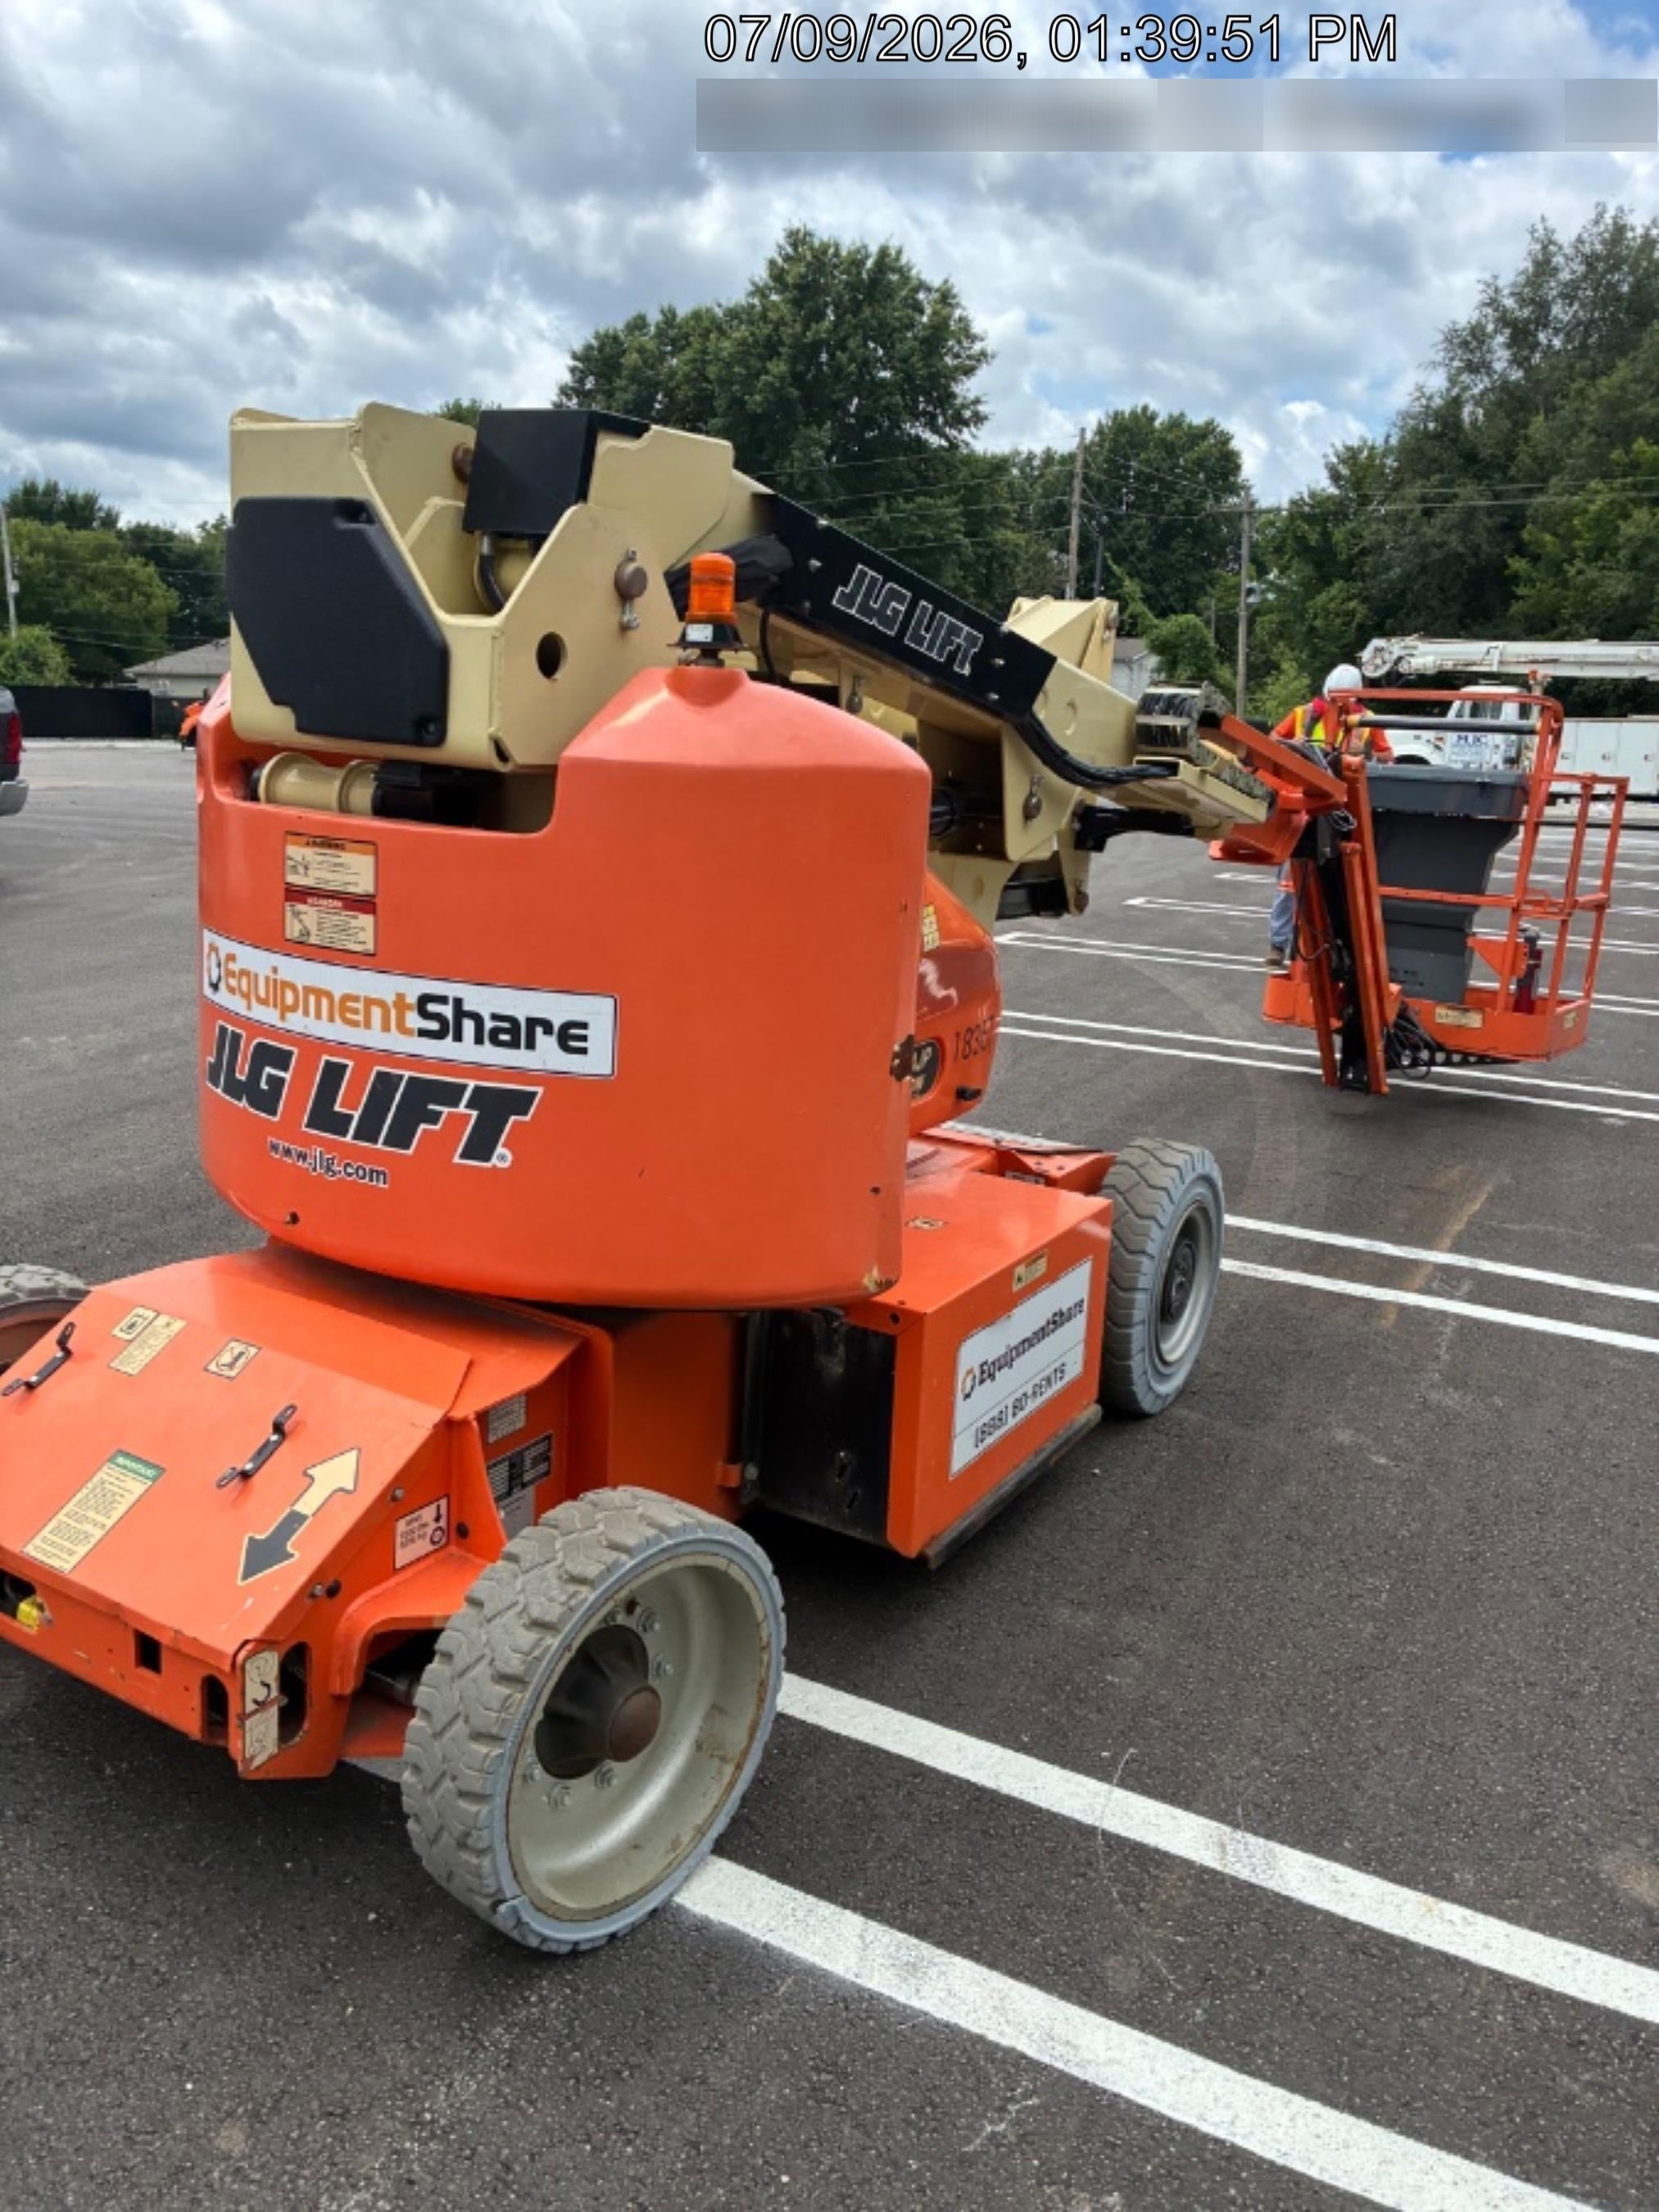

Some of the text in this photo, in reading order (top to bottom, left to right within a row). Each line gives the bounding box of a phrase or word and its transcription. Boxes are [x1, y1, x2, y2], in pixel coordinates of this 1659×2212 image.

[832, 563, 984, 677] JLG LIFT
[224, 952, 590, 1055] EquipmentShare
[206, 1021, 297, 1120] JLG
[269, 1137, 389, 1187] www.jlg.com
[977, 1297, 1086, 1388] EquipmentShare
